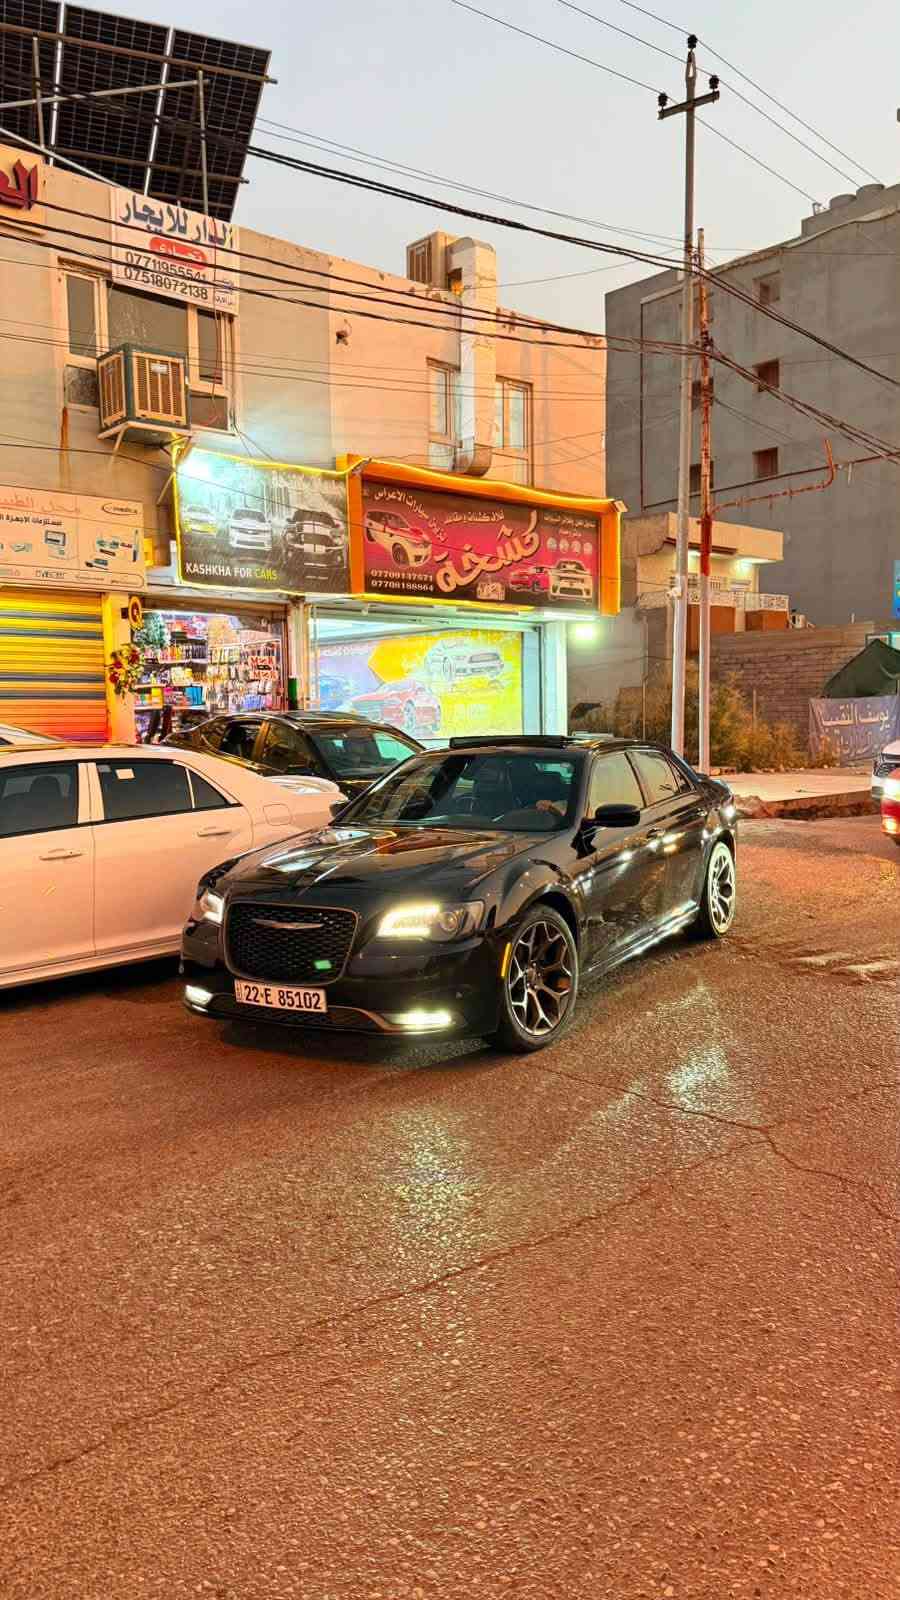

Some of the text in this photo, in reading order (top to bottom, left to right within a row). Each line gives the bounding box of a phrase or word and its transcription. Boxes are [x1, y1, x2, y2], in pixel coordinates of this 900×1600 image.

[185, 561, 232, 577] KASHKHA
[233, 566, 252, 578] FOR
[278, 989, 322, 1010] 85102
